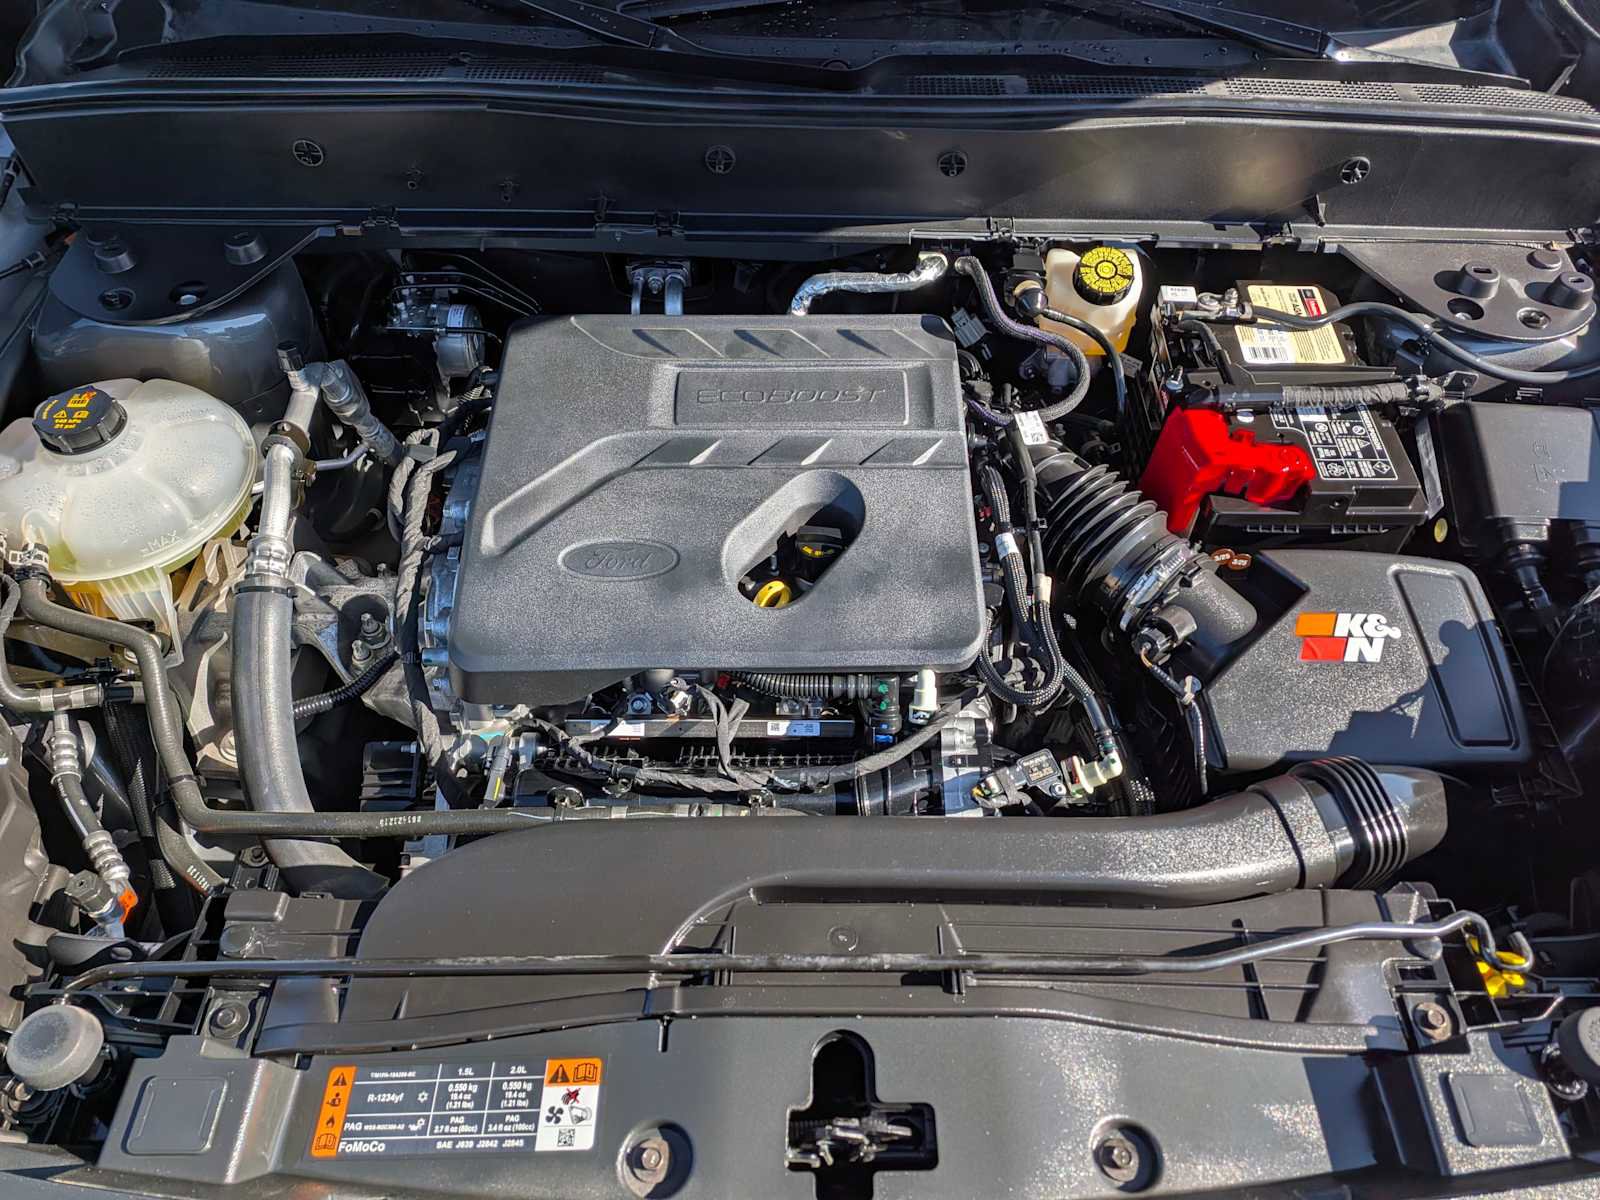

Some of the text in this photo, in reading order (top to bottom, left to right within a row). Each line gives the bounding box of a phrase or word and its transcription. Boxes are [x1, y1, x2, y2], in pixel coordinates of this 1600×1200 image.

[697, 389, 884, 403] ECOBOOST
[147, 532, 184, 552] MAX
[585, 546, 657, 569] Ford
[458, 1067, 474, 1076] 1.5L
[510, 1066, 527, 1074] 2.0L
[448, 1082, 478, 1093] 0.550 kg
[502, 1081, 532, 1091] 0.550 kg
[367, 1092, 405, 1104] R-1234yf
[450, 1092, 463, 1100] 19.4
[450, 1116, 464, 1124] PAG
[505, 1114, 520, 1122] PAG
[343, 1122, 362, 1131] PAG
[338, 1141, 386, 1153] FoMoCo
[436, 1140, 453, 1149] SAE
